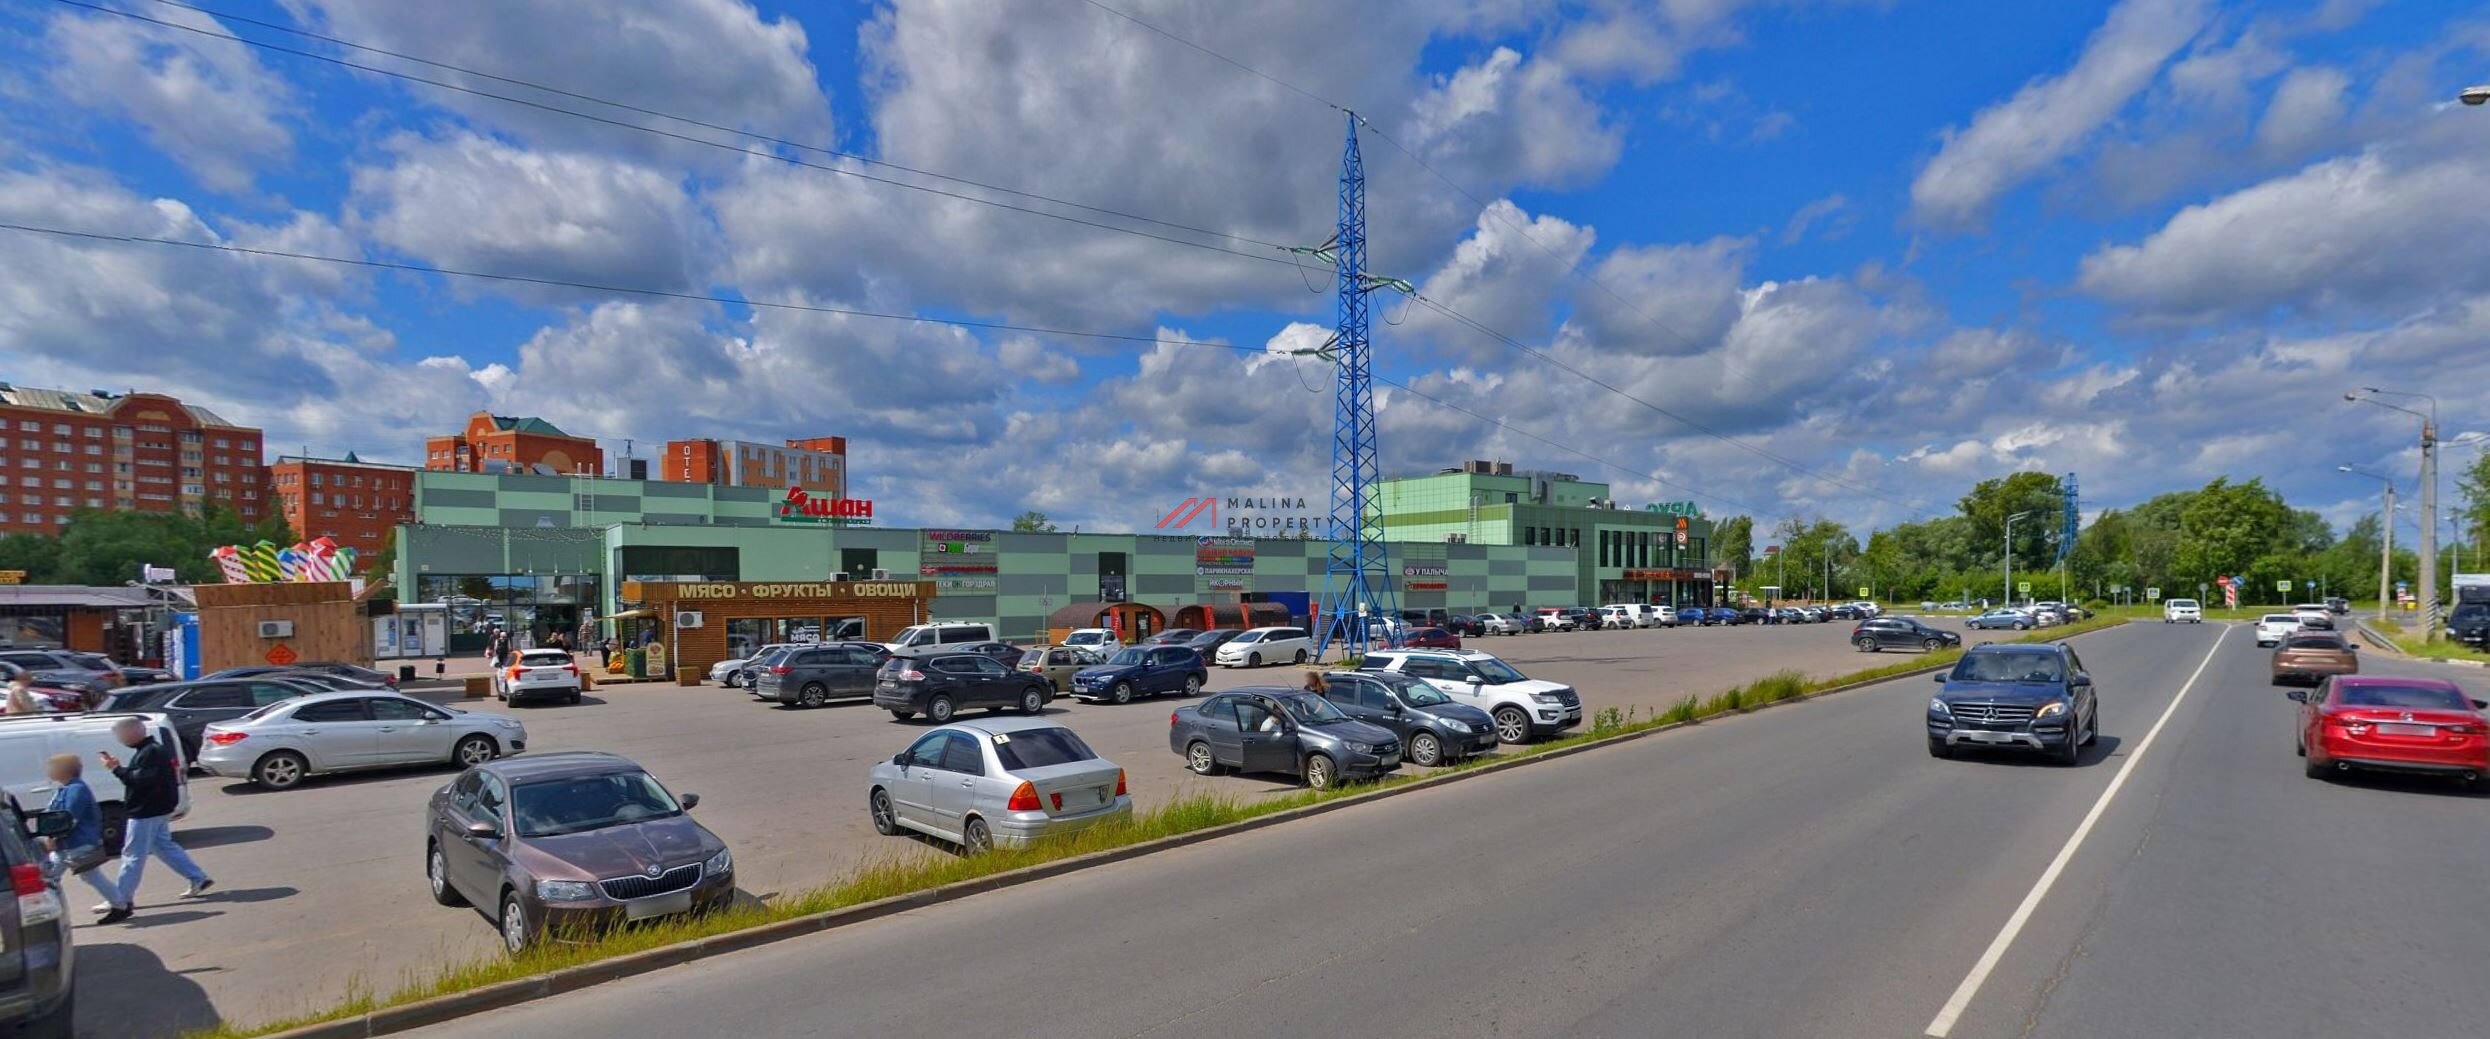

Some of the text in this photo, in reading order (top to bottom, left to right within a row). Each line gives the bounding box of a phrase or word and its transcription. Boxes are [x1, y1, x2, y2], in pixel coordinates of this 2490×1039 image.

[683, 445, 692, 482] ОТЕ
[928, 531, 991, 542] WILDBERRIES
[678, 583, 917, 599] МЯСО ФРУКТЫ ОВОЩИ
[790, 633, 820, 642] МЯСО
